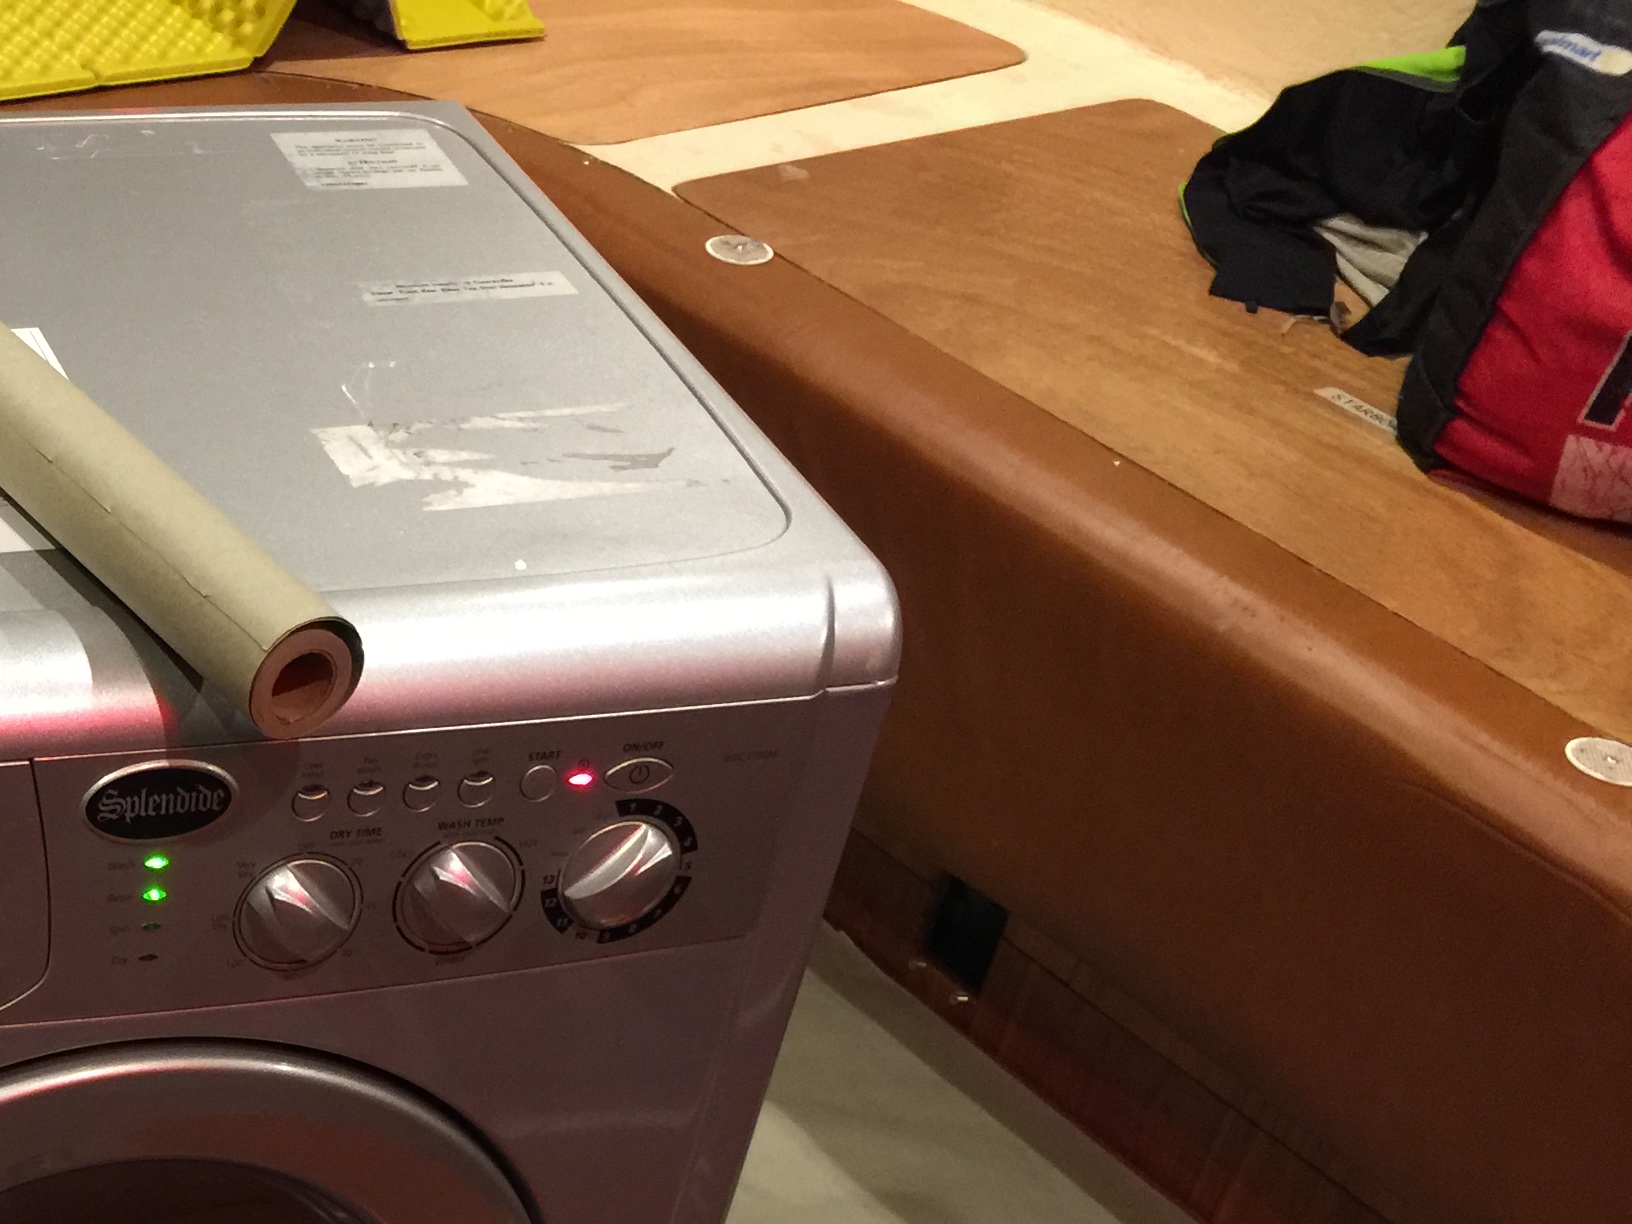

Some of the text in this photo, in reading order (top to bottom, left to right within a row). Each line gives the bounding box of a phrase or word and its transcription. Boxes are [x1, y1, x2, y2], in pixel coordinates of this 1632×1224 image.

[622, 740, 665, 753] ON/OFF
[528, 749, 562, 762] START
[97, 784, 225, 824] Splendide
[437, 817, 505, 831] WASH TEMP
[329, 827, 382, 840] DRY TIME
